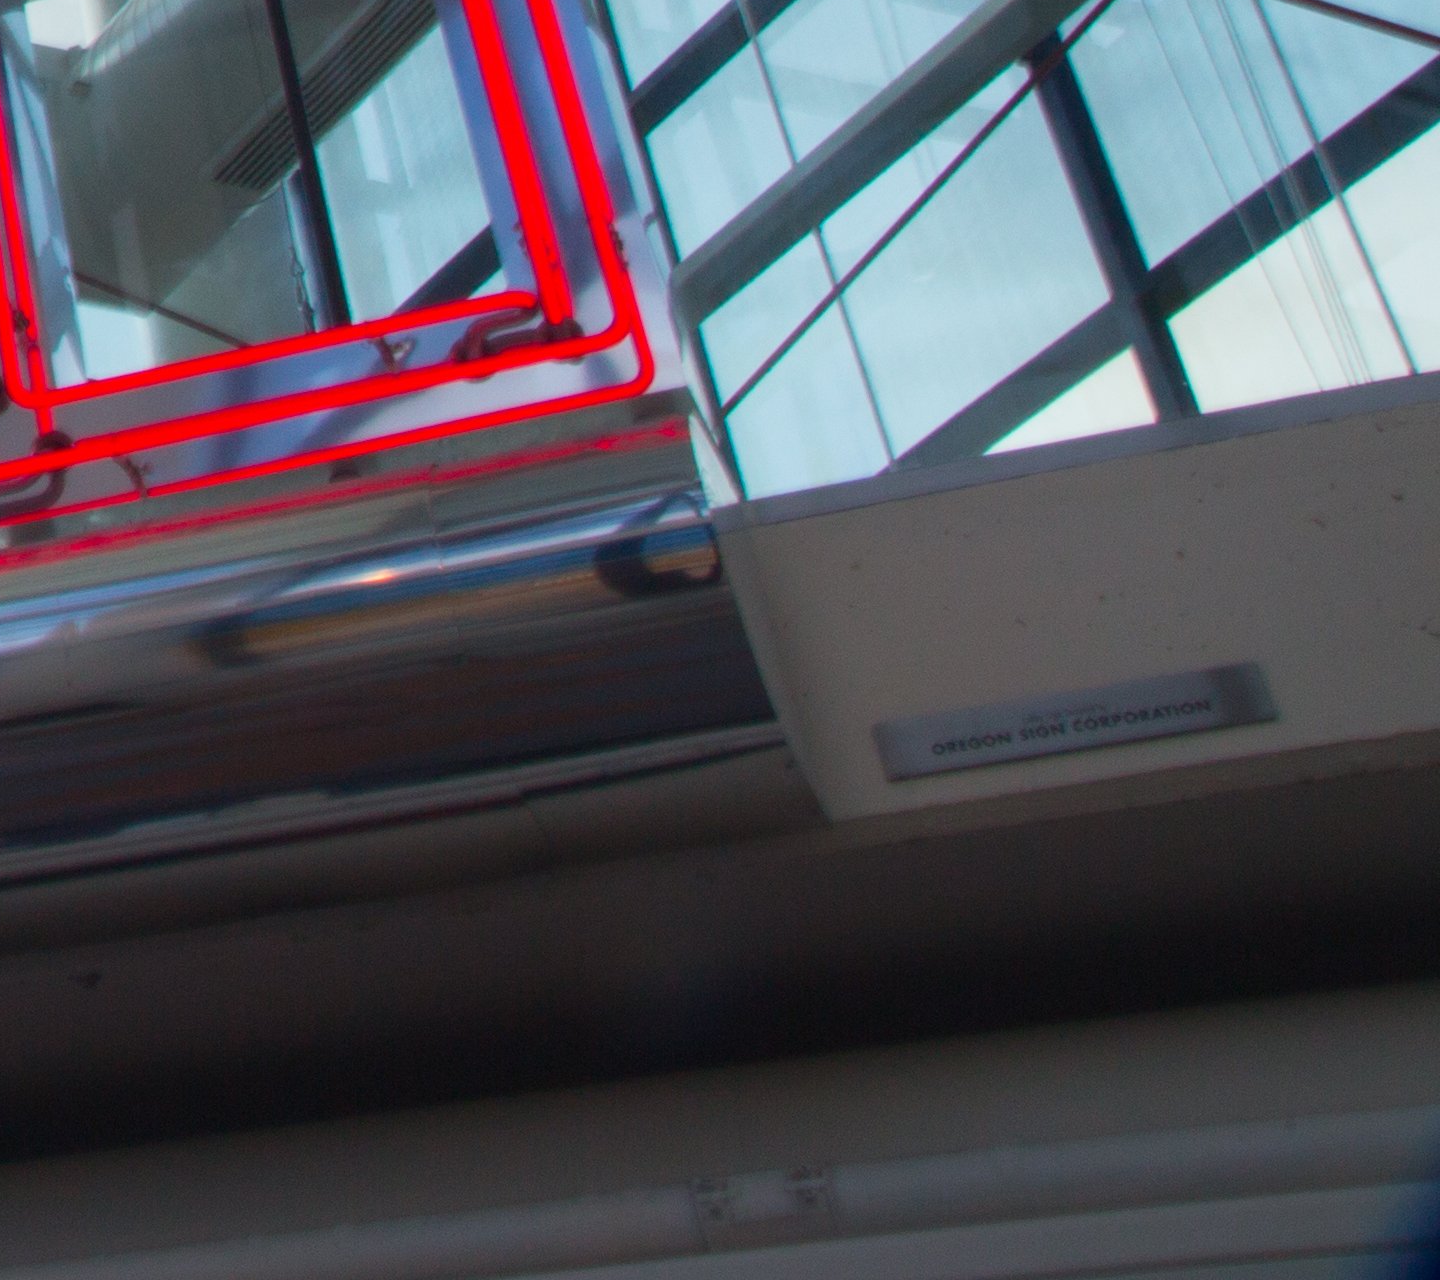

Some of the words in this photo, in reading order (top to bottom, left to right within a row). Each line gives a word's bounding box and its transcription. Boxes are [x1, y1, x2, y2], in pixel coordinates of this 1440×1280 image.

[931, 732, 1011, 757] OREGON
[1019, 722, 1066, 742] SIGN
[1072, 699, 1212, 733] CORPORATION
